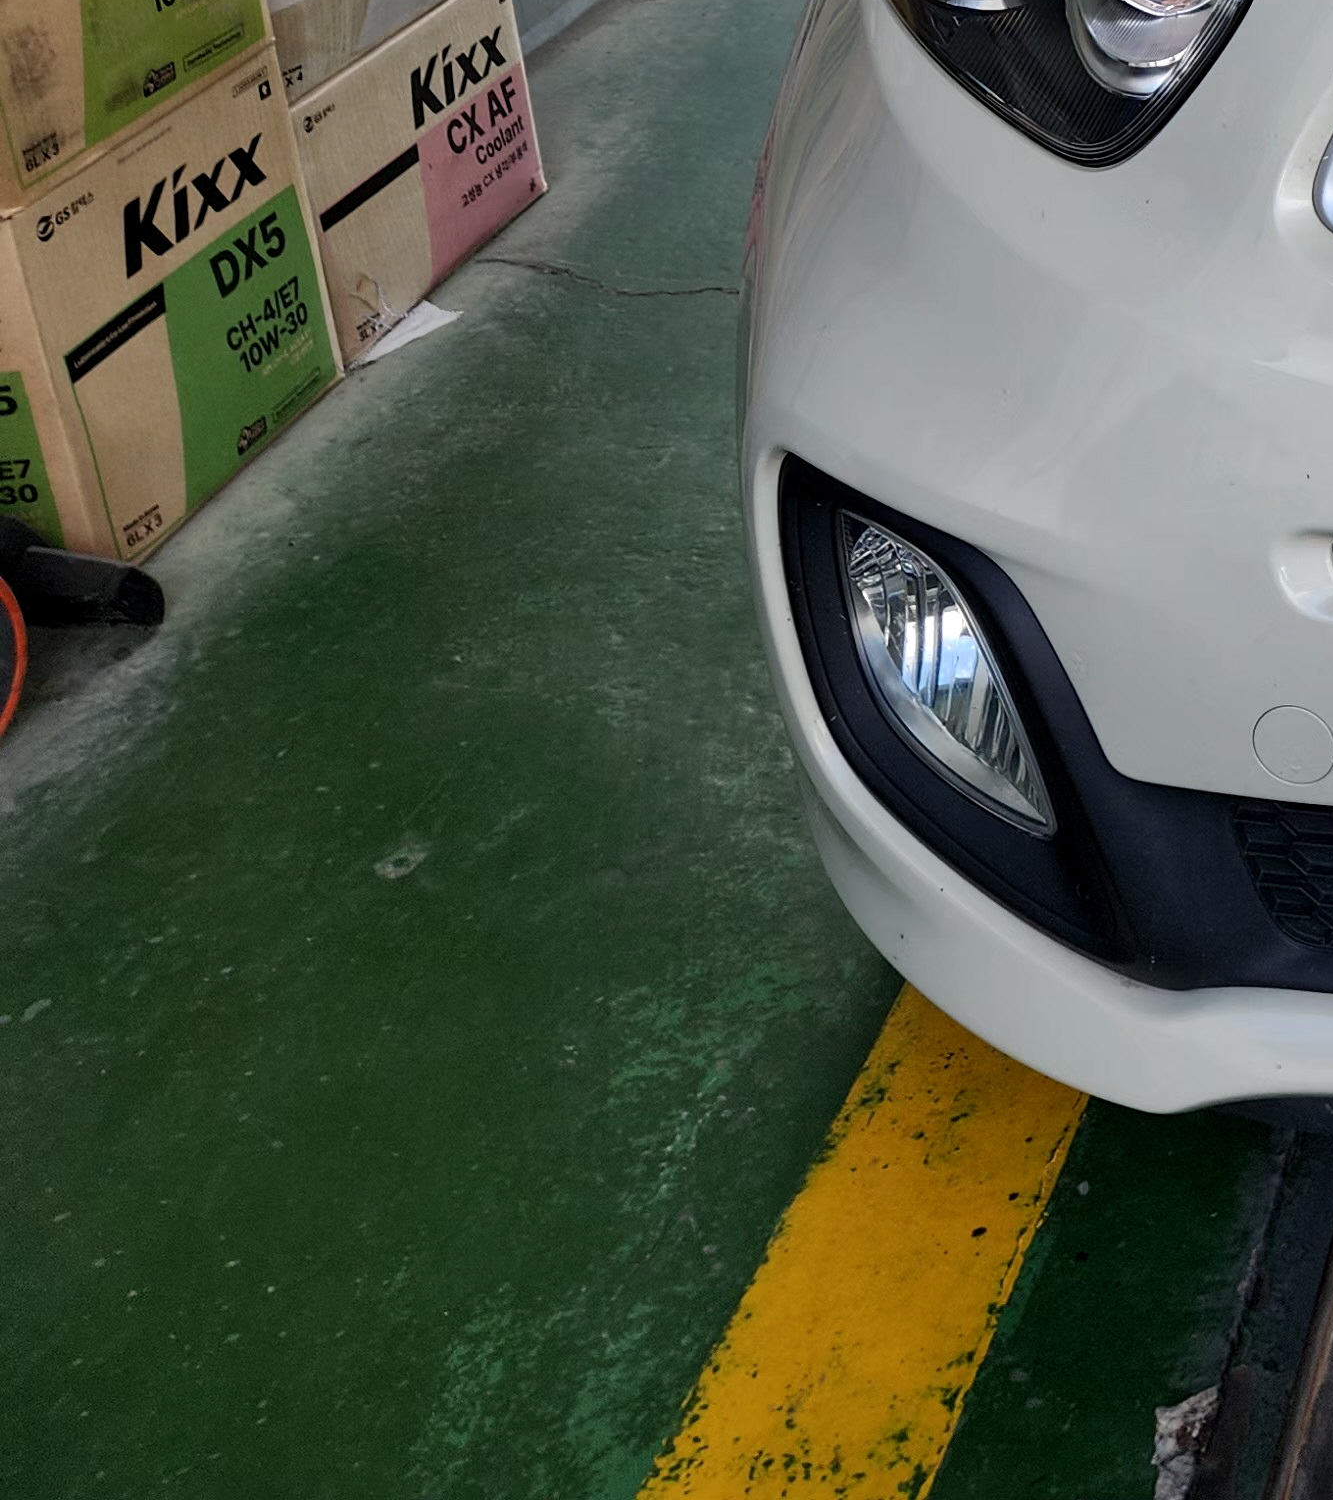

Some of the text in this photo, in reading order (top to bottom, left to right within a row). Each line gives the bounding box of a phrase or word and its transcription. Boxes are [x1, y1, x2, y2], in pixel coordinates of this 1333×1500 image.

[410, 26, 507, 130] Kixx
[447, 76, 516, 154] CX AF
[475, 115, 524, 164] Coolant
[55, 205, 71, 225] GS
[124, 132, 267, 279] Kixx
[209, 212, 286, 298] DX5
[226, 276, 299, 351] CH-4/E7
[240, 302, 308, 372] 10W-30
